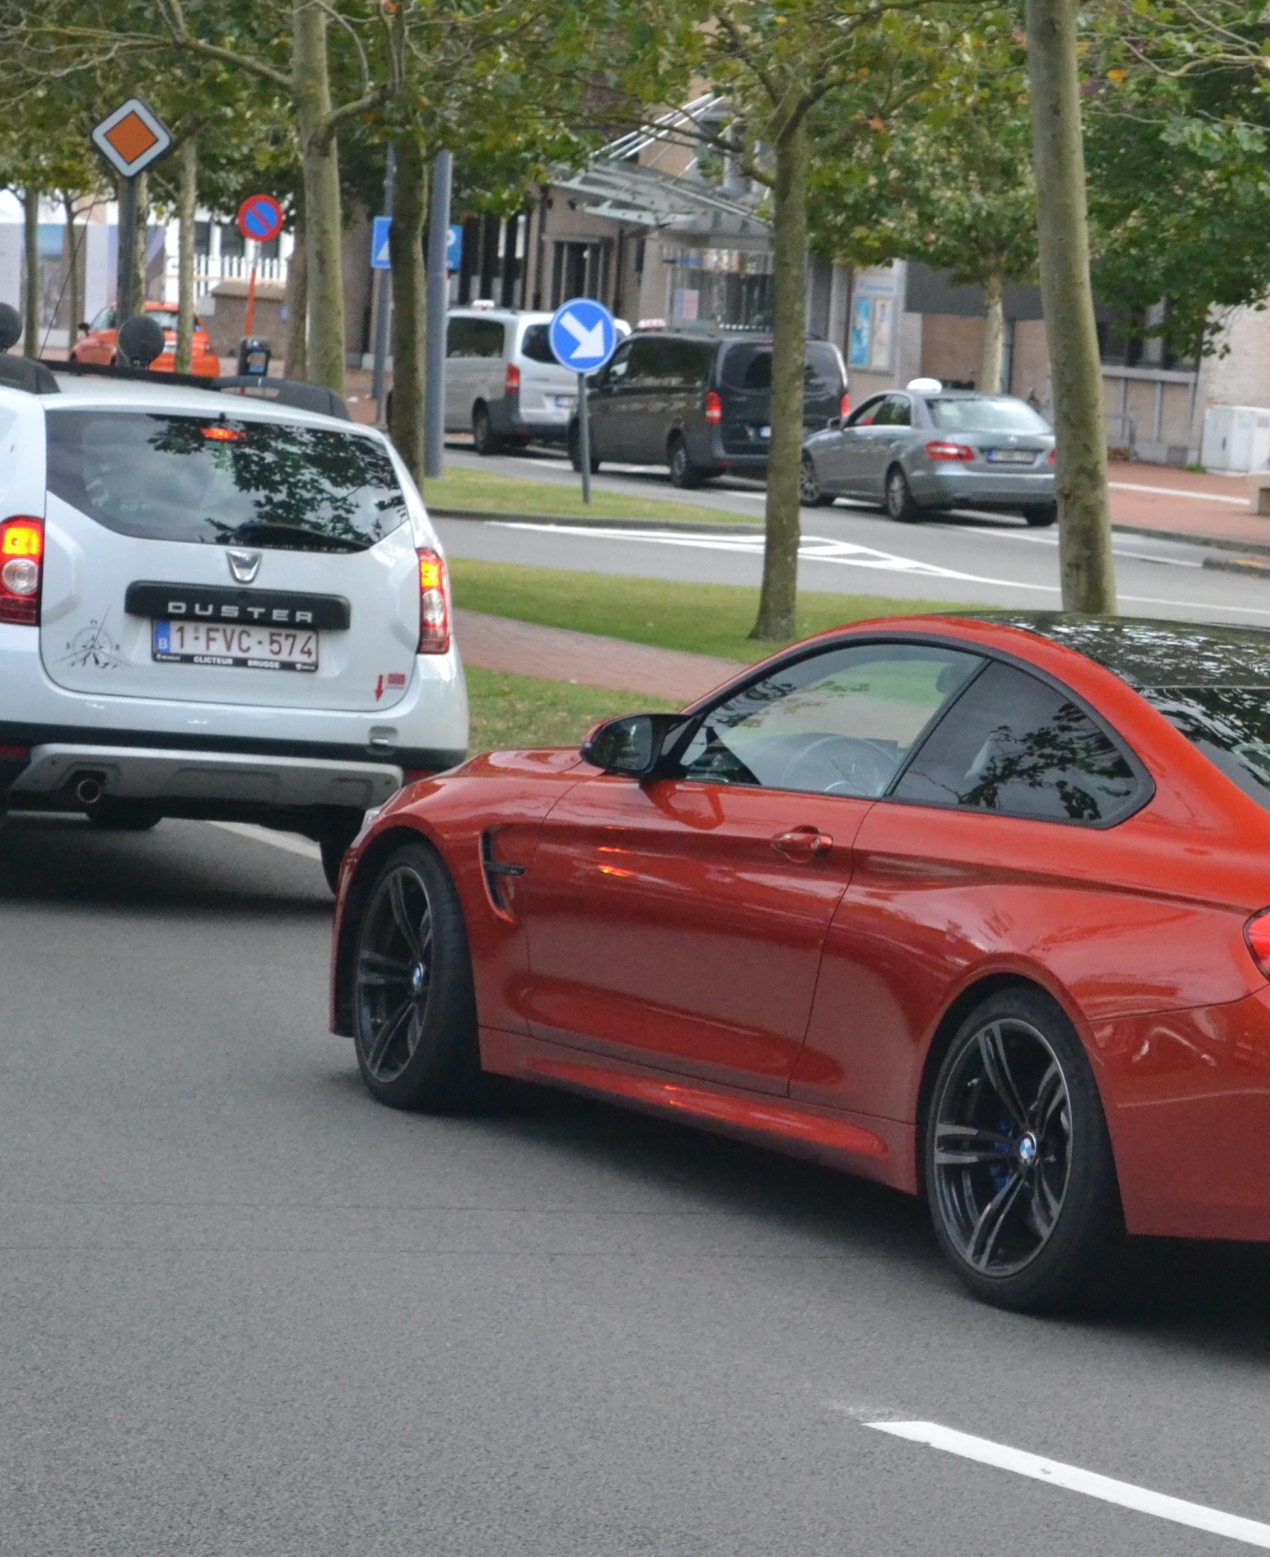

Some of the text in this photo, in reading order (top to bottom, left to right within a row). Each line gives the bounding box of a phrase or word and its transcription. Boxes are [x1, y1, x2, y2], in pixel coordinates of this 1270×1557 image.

[168, 602, 313, 623] DUSTER
[158, 638, 168, 650] B
[175, 625, 313, 659] 1-FVC-574
[247, 659, 280, 669] BRUGGE
